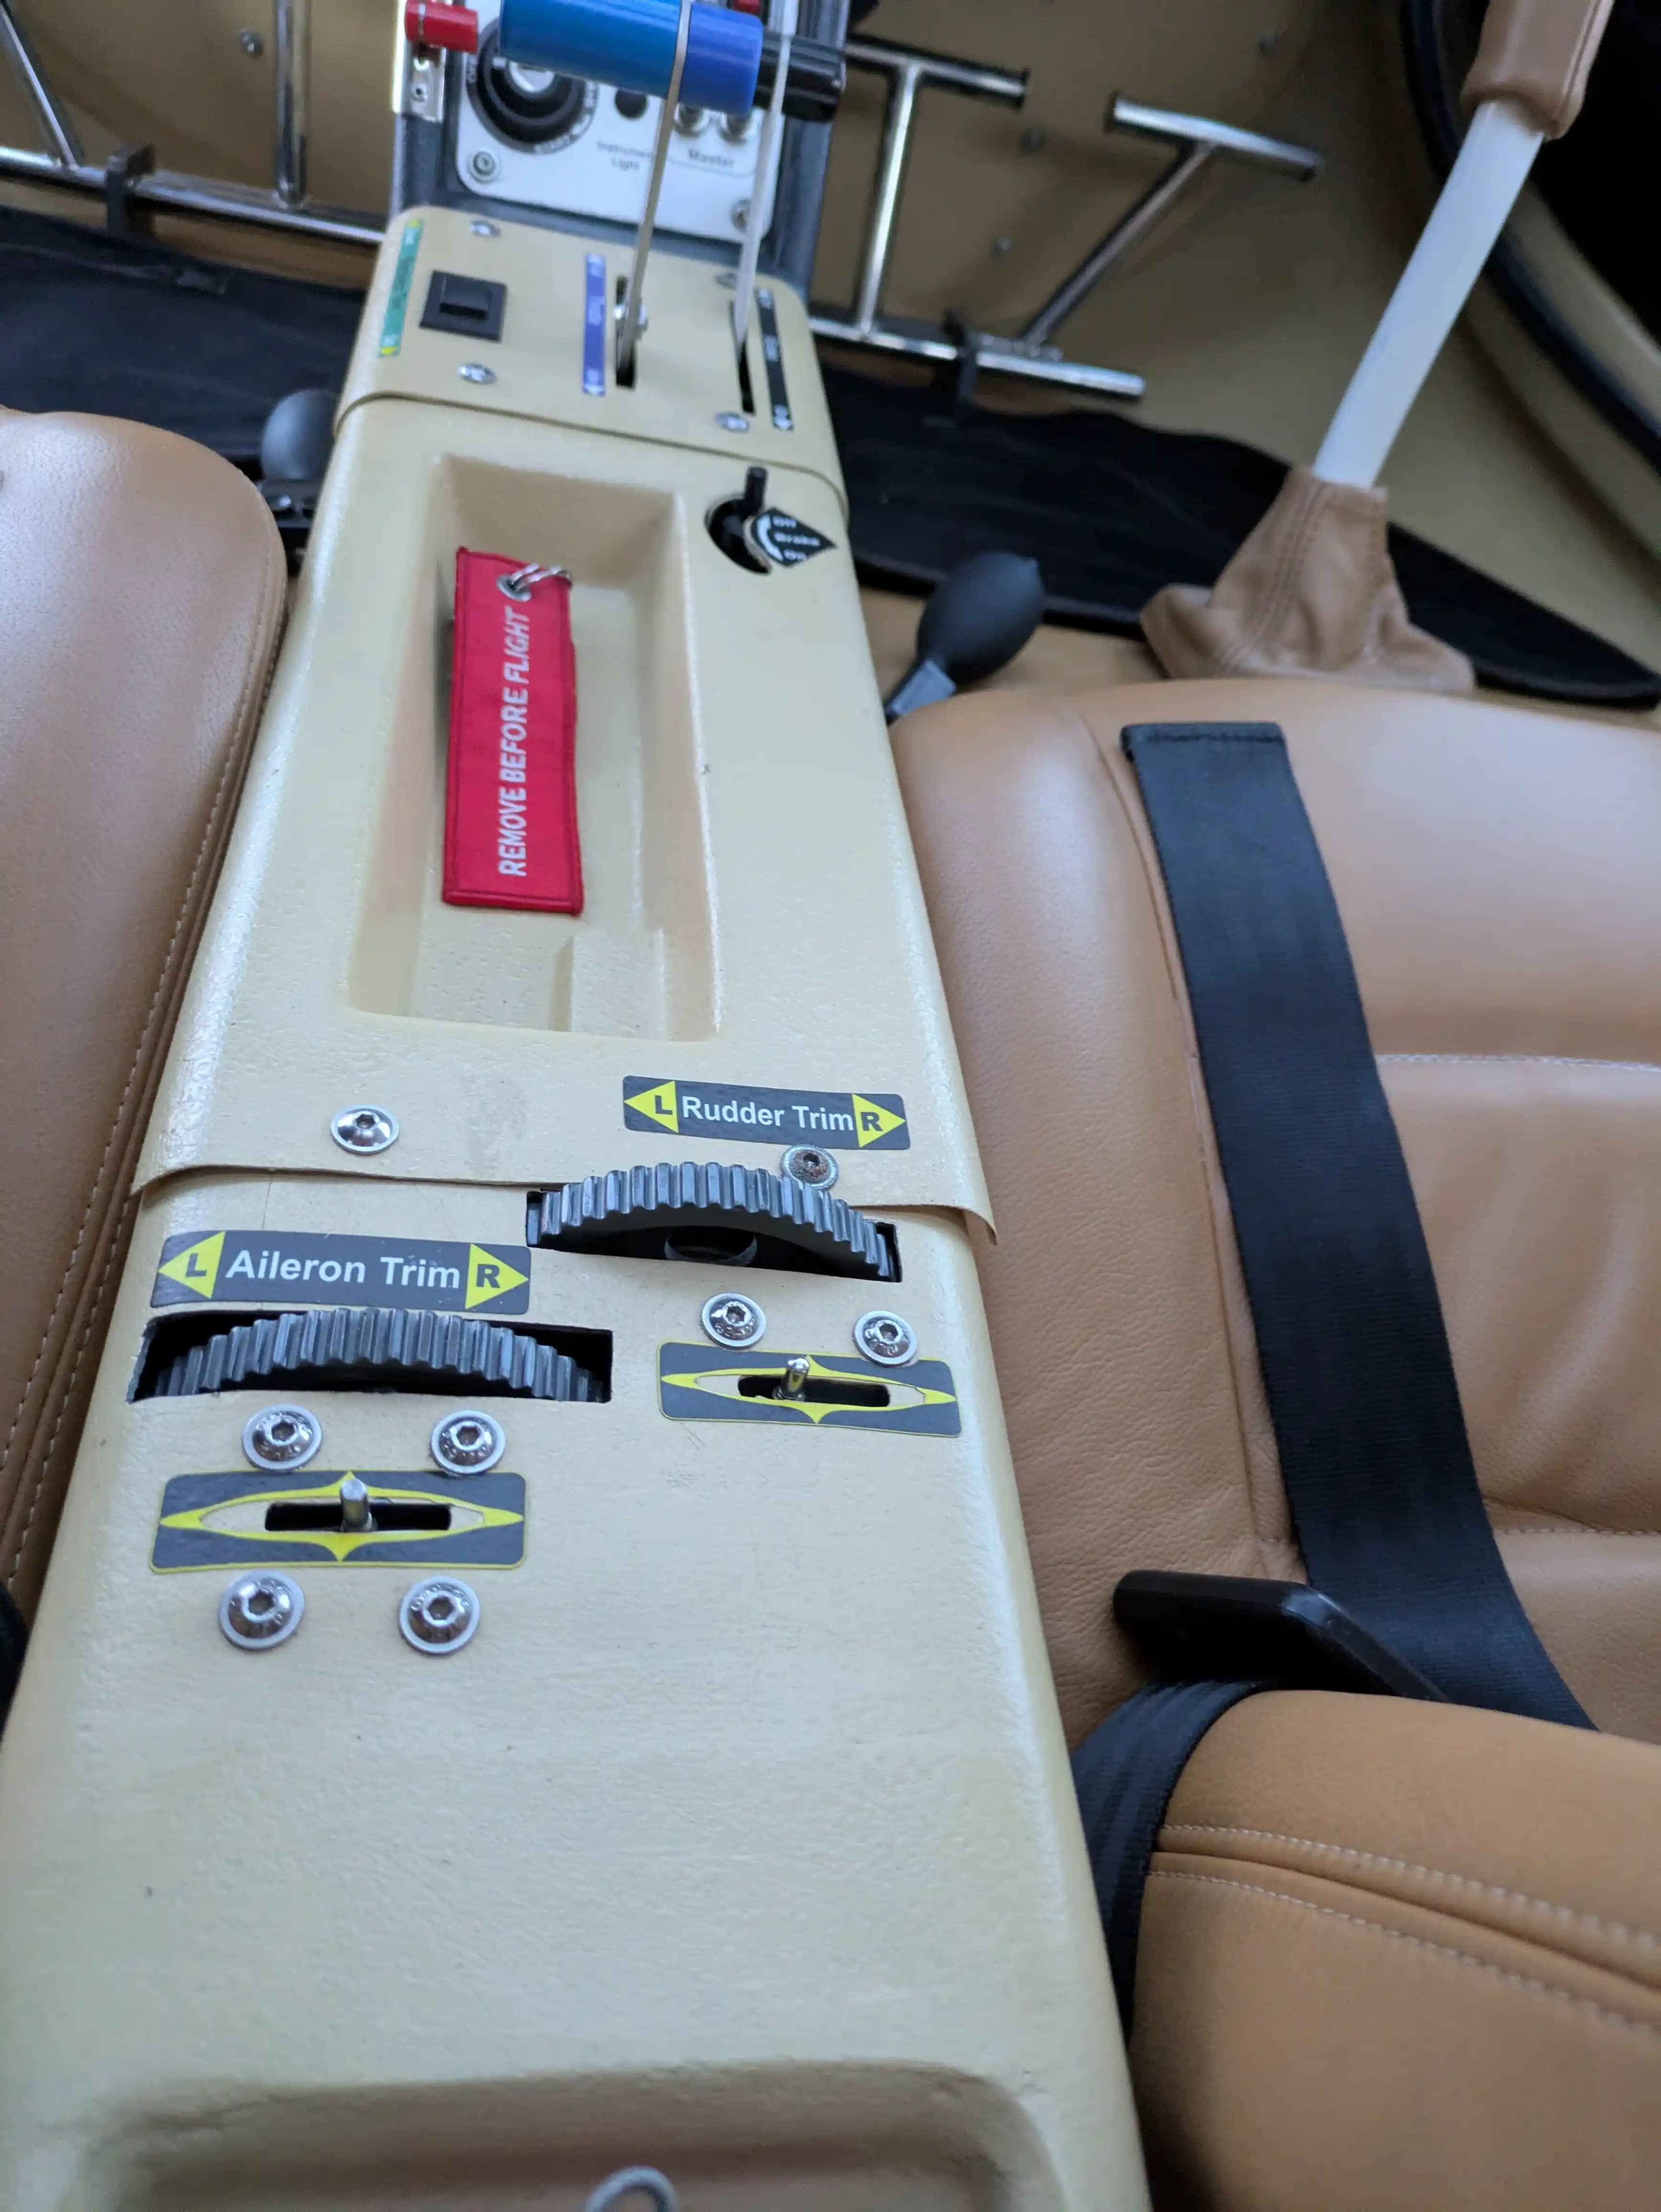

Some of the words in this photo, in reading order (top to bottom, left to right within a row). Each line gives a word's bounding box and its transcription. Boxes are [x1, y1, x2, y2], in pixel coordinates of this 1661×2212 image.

[504, 606, 531, 684] FLIGHT
[499, 686, 529, 783] BEFORE
[498, 787, 527, 877] REMOVE
[654, 1095, 673, 1116] L
[682, 1095, 785, 1127] Rudder
[792, 1105, 854, 1131] Trim
[860, 1111, 883, 1132] R
[185, 1253, 208, 1278] L
[225, 1250, 365, 1283] Aileron
[380, 1256, 460, 1289] Trim
[476, 1263, 501, 1288] R
